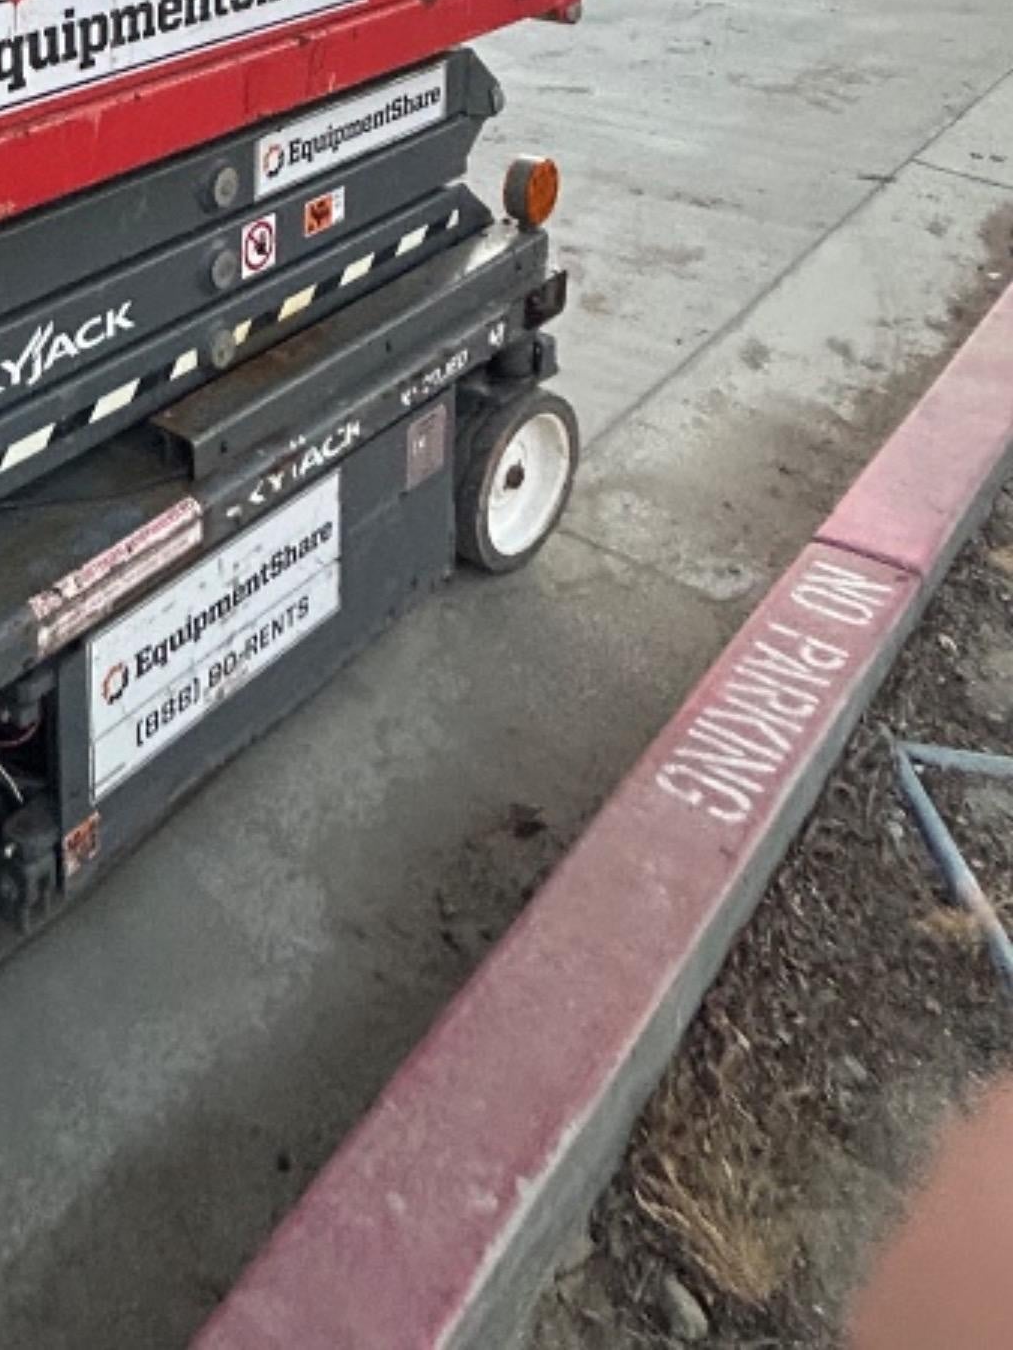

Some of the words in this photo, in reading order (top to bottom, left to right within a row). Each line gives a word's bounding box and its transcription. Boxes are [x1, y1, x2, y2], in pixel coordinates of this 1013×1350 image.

[287, 82, 442, 167] EquipmentShare
[134, 521, 334, 678] EquipmentShare
[790, 559, 893, 627] NO
[654, 620, 850, 823] PARKING
